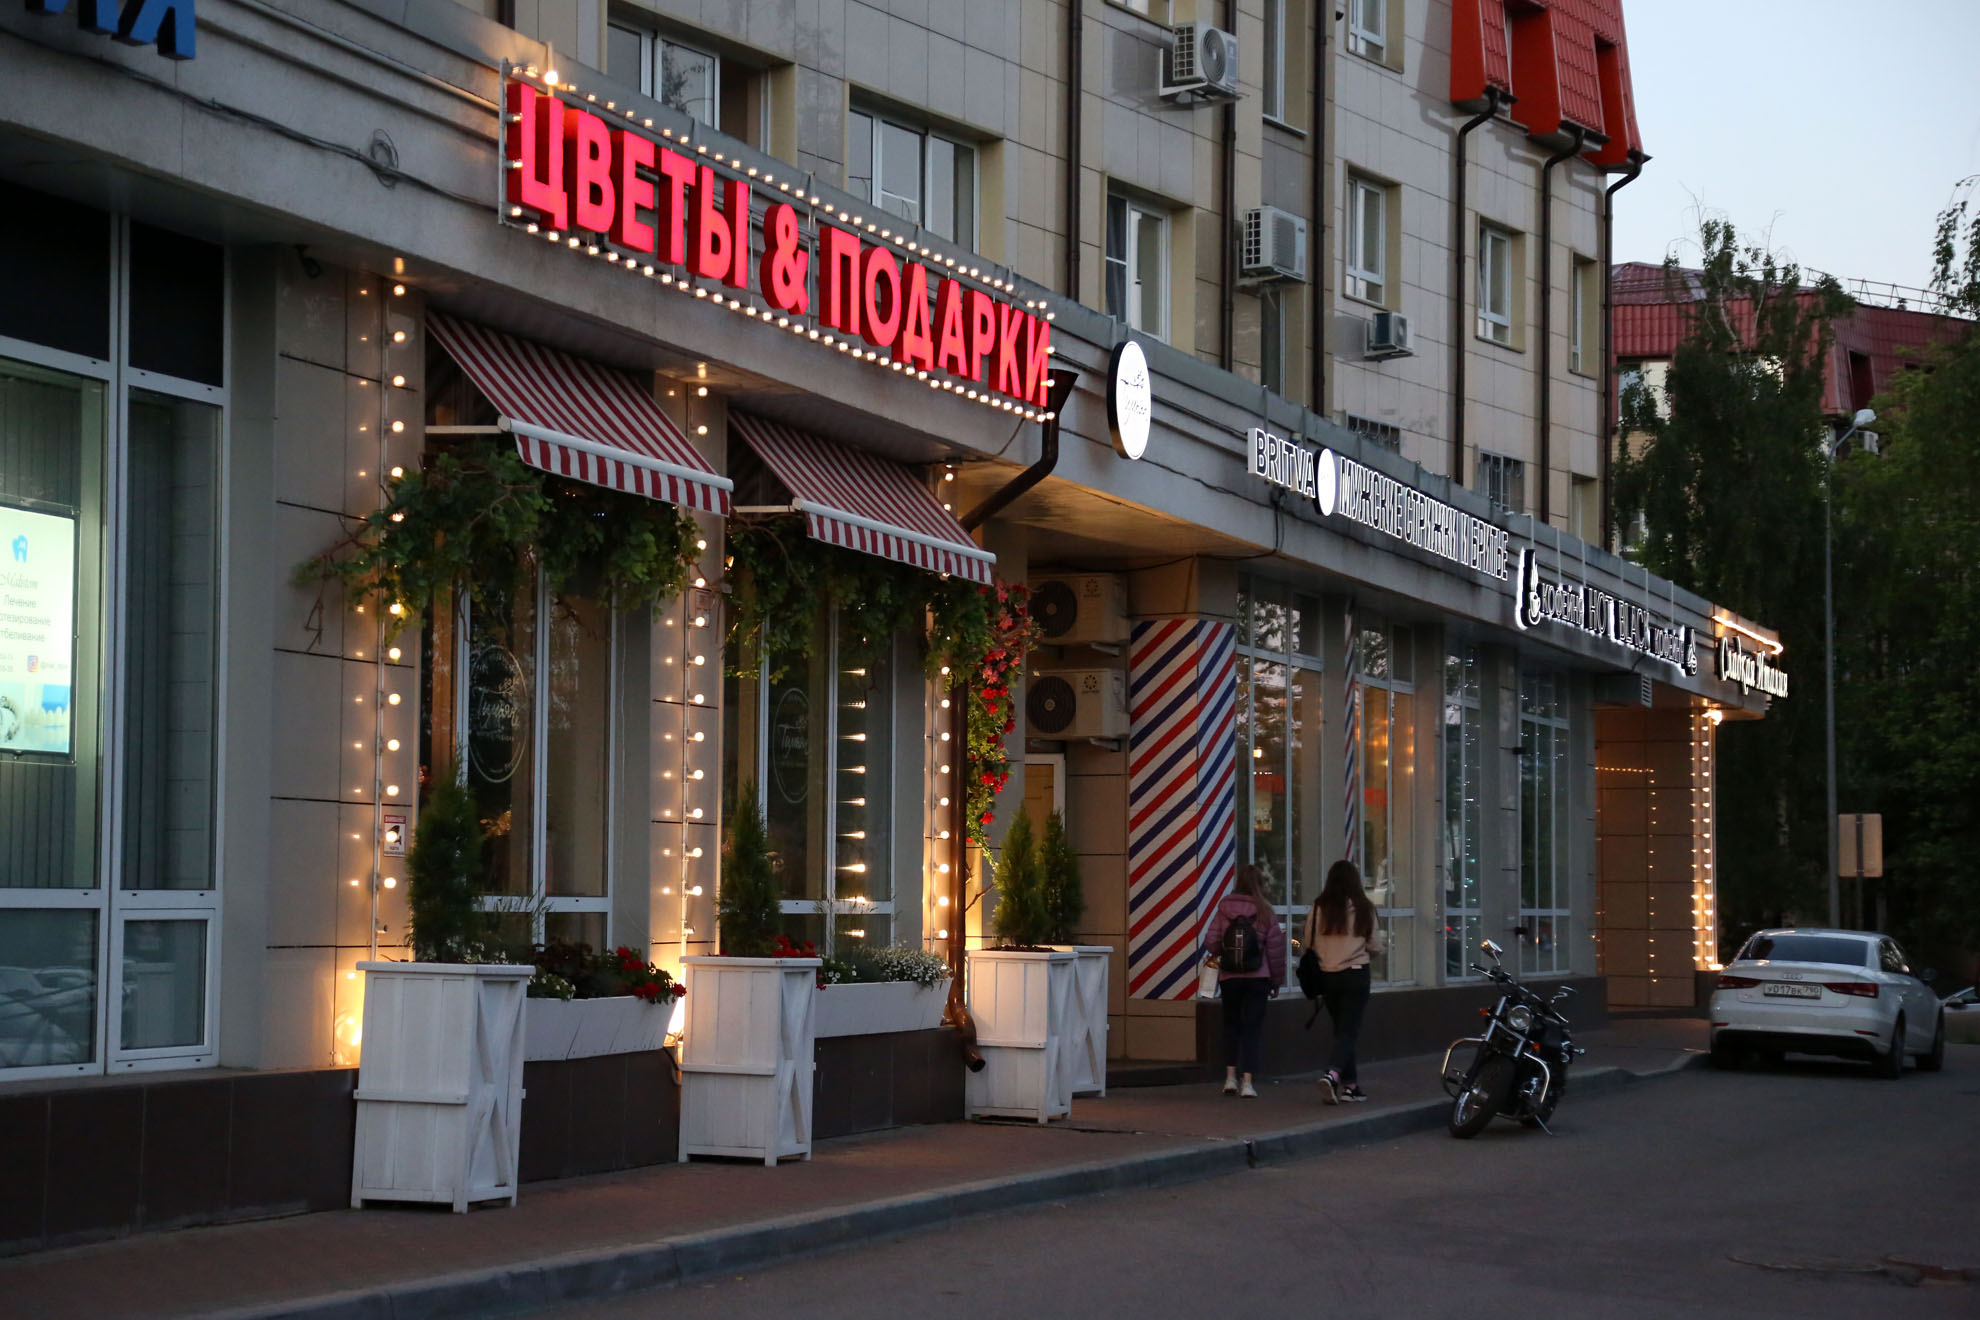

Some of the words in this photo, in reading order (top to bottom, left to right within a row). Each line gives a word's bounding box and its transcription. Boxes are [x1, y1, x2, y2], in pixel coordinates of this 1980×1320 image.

[507, 83, 749, 289] ЦВЕТЫ
[760, 203, 809, 315] &
[819, 226, 1051, 407] ПОДАРКИ
[1250, 428, 1316, 499] BRITVA
[1339, 457, 1402, 539] МУЖСКИЕ
[1405, 487, 1459, 562] СТРИЖКИ
[1461, 513, 1469, 566] И
[1471, 517, 1508, 581] БРИТЬЕ
[1542, 583, 1584, 625] КОФЕЙНЯ
[1589, 588, 1614, 636] HOT
[1619, 600, 1649, 649] BLACK
